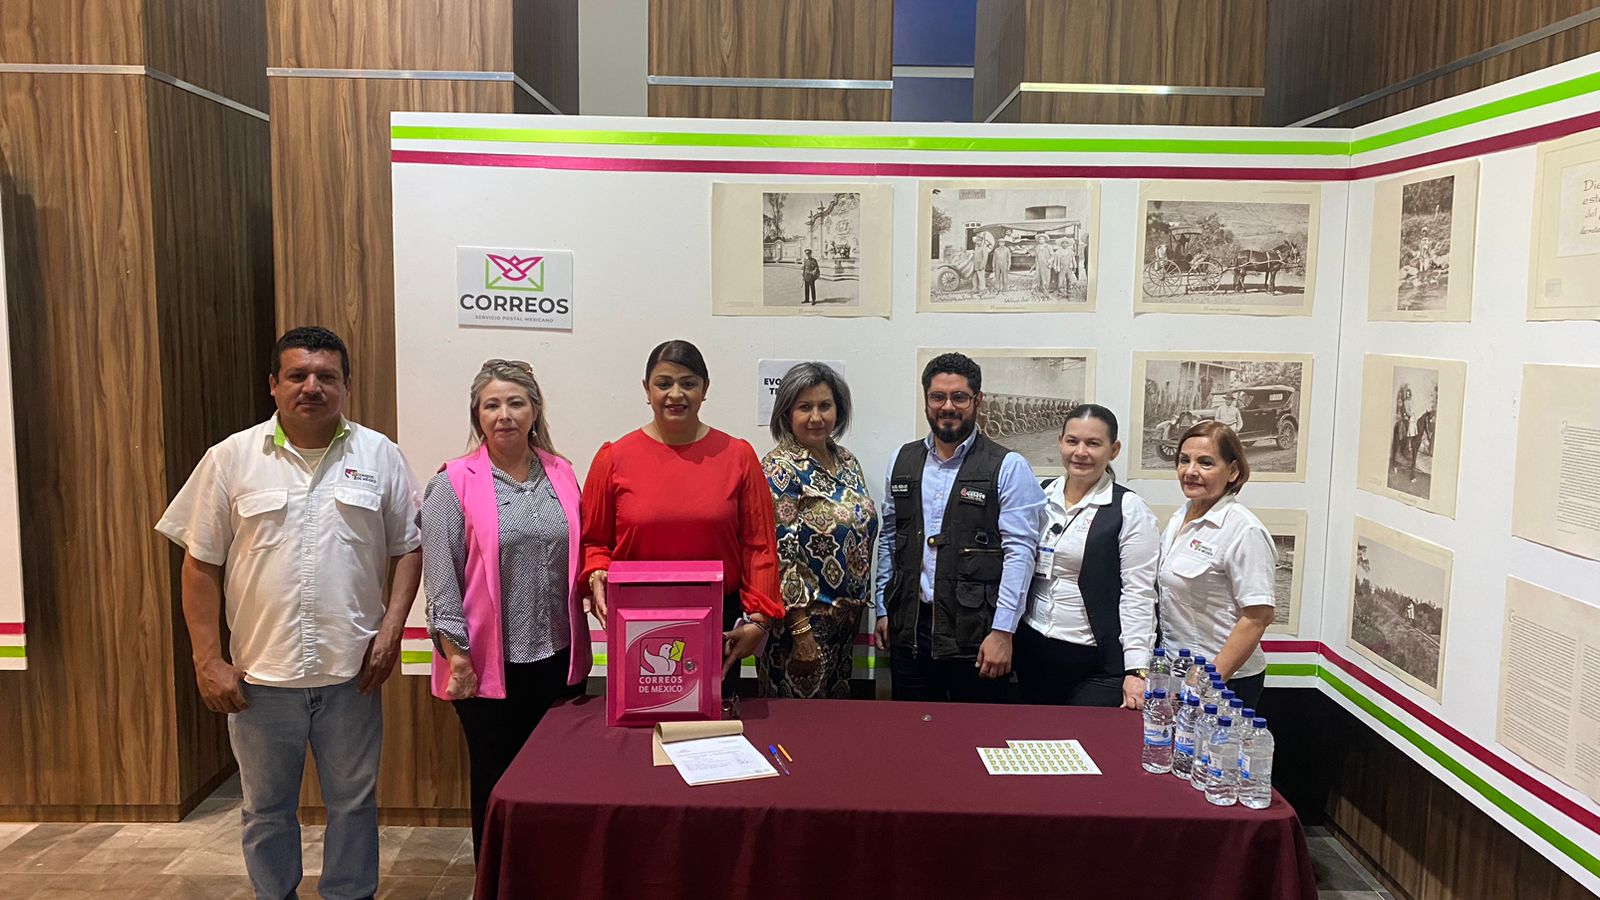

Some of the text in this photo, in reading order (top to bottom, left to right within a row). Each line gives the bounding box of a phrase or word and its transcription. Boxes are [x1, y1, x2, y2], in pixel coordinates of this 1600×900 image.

[1582, 193, 1600, 205] est
[460, 294, 569, 314] CORREOS
[639, 676, 683, 684] CORREOS
[639, 684, 683, 693] DE MÉXICO
